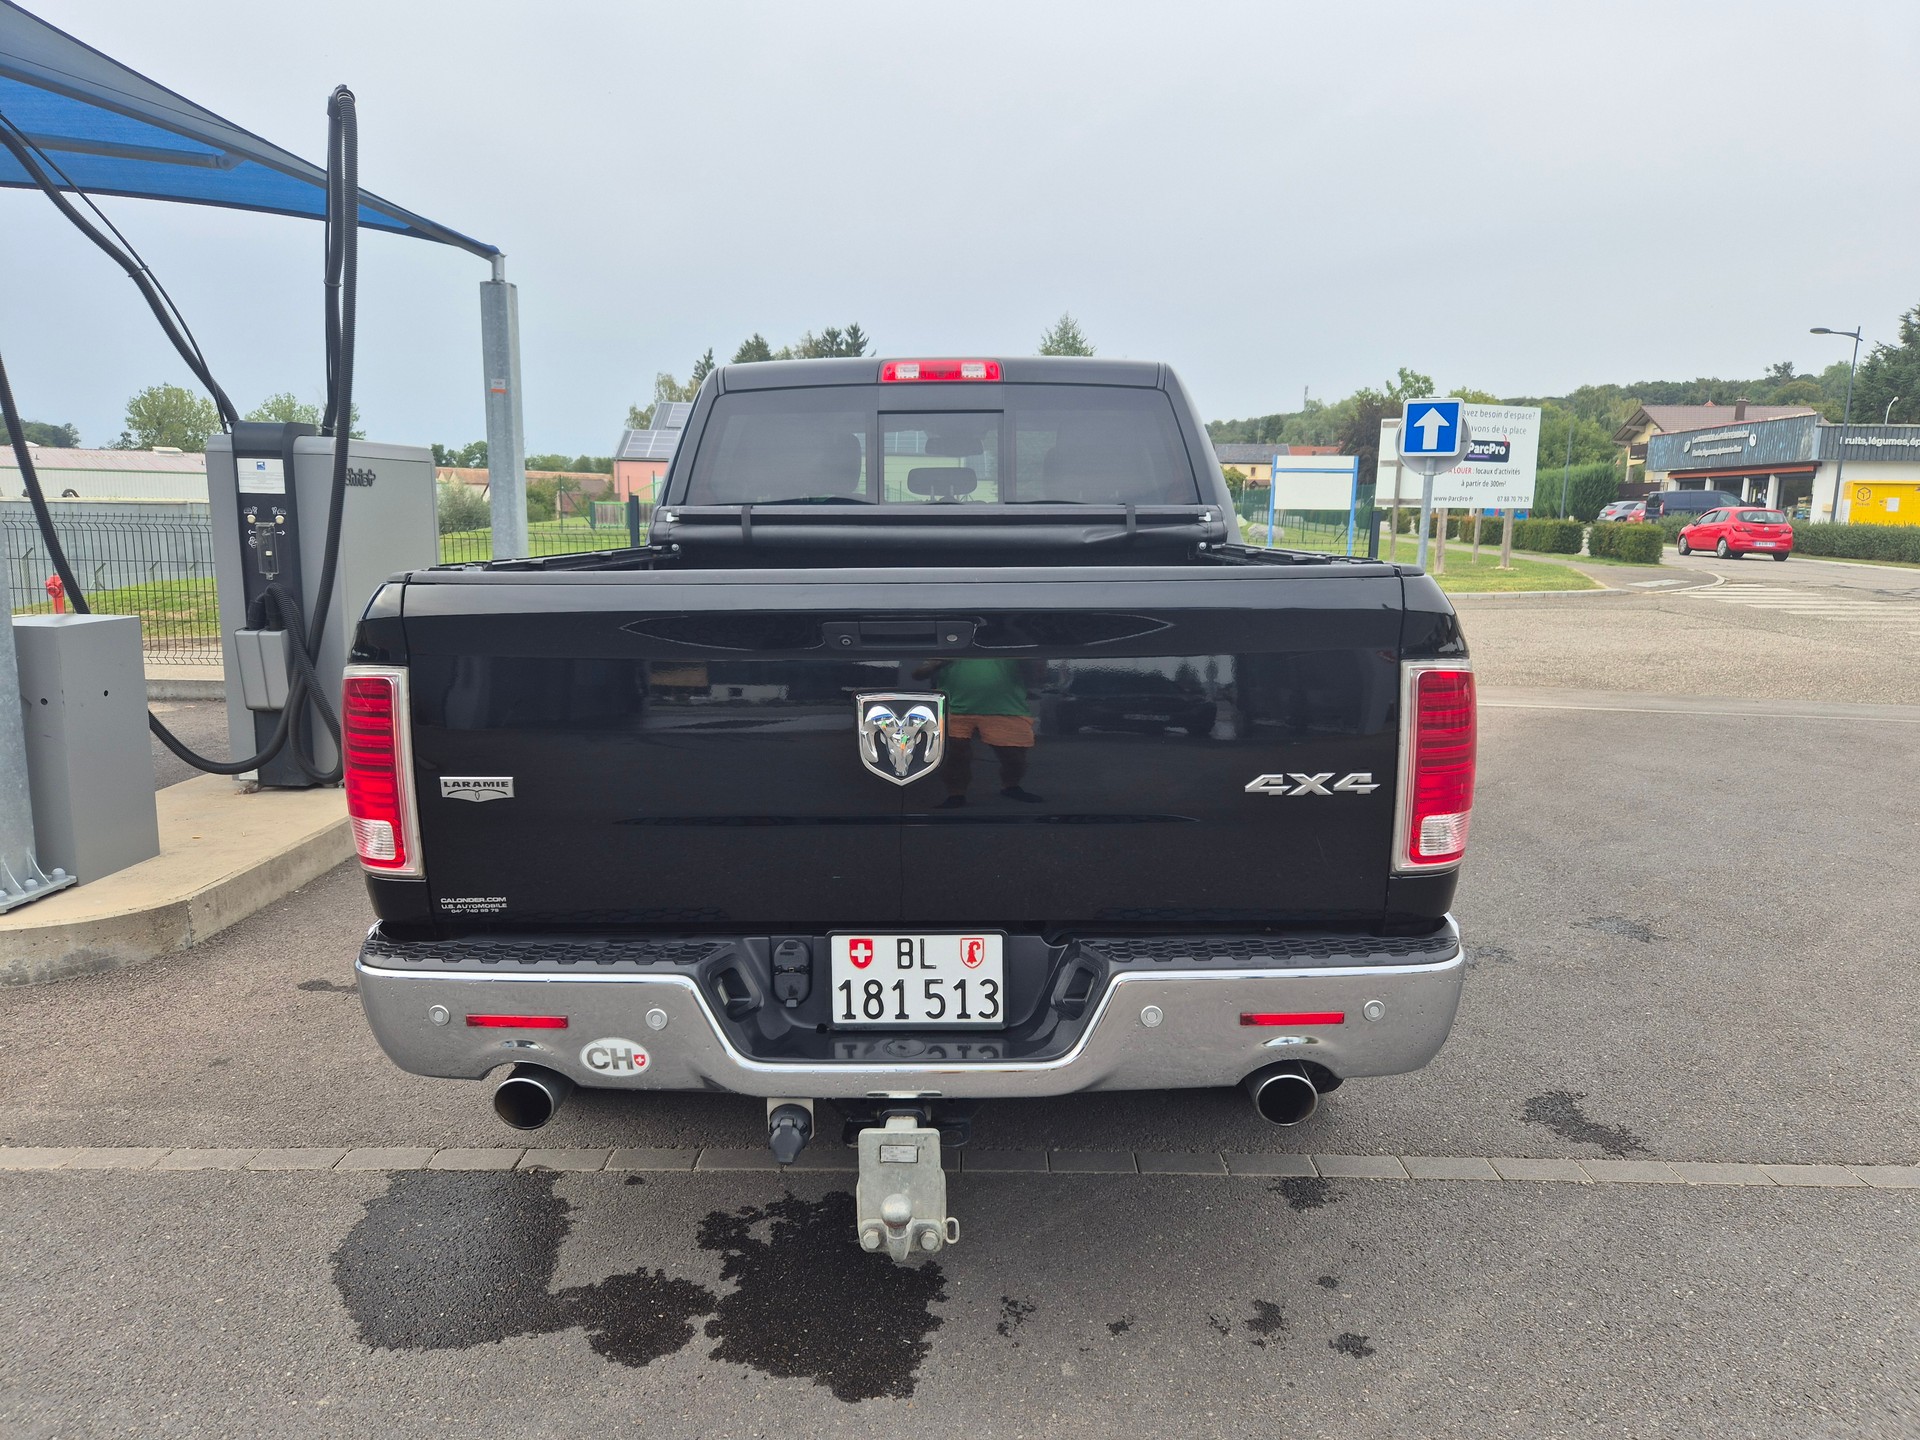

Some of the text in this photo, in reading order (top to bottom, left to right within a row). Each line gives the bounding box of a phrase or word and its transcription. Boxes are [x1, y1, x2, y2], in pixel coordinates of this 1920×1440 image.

[1480, 409, 1502, 418] besoin
[1504, 410, 1536, 420] d'espace?
[1492, 425, 1500, 433] de
[1502, 425, 1507, 433] la
[1510, 426, 1527, 435] place
[1468, 442, 1506, 455] ParcPro
[1465, 480, 1481, 488] partir
[897, 938, 937, 969] BL
[586, 1047, 634, 1070] CH
